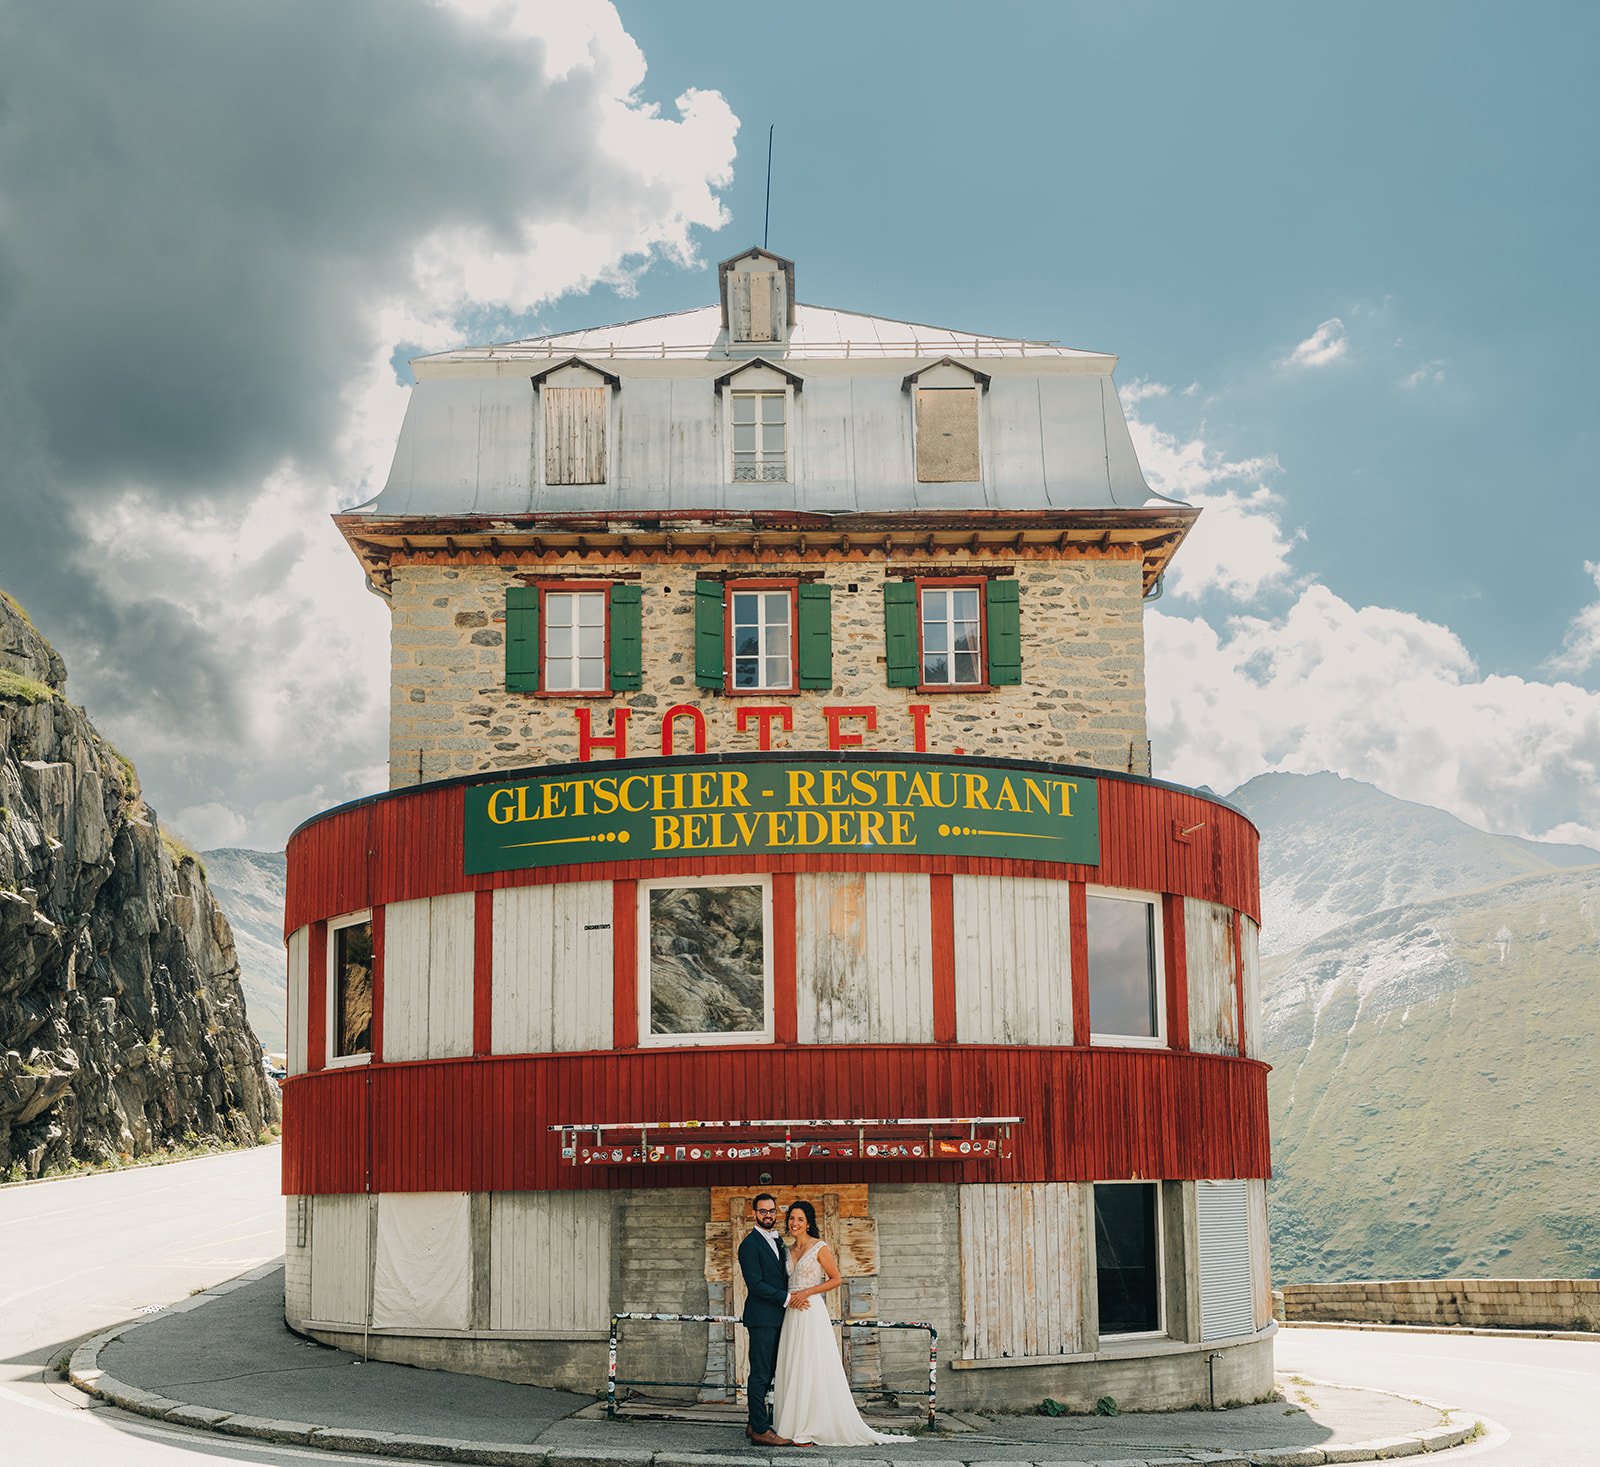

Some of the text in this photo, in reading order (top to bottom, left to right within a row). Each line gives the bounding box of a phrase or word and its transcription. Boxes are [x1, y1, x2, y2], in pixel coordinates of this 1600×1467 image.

[487, 771, 752, 825] GLETSCHER
[785, 770, 1078, 819] RESTAURANT
[651, 810, 917, 851] BELVEDERE
